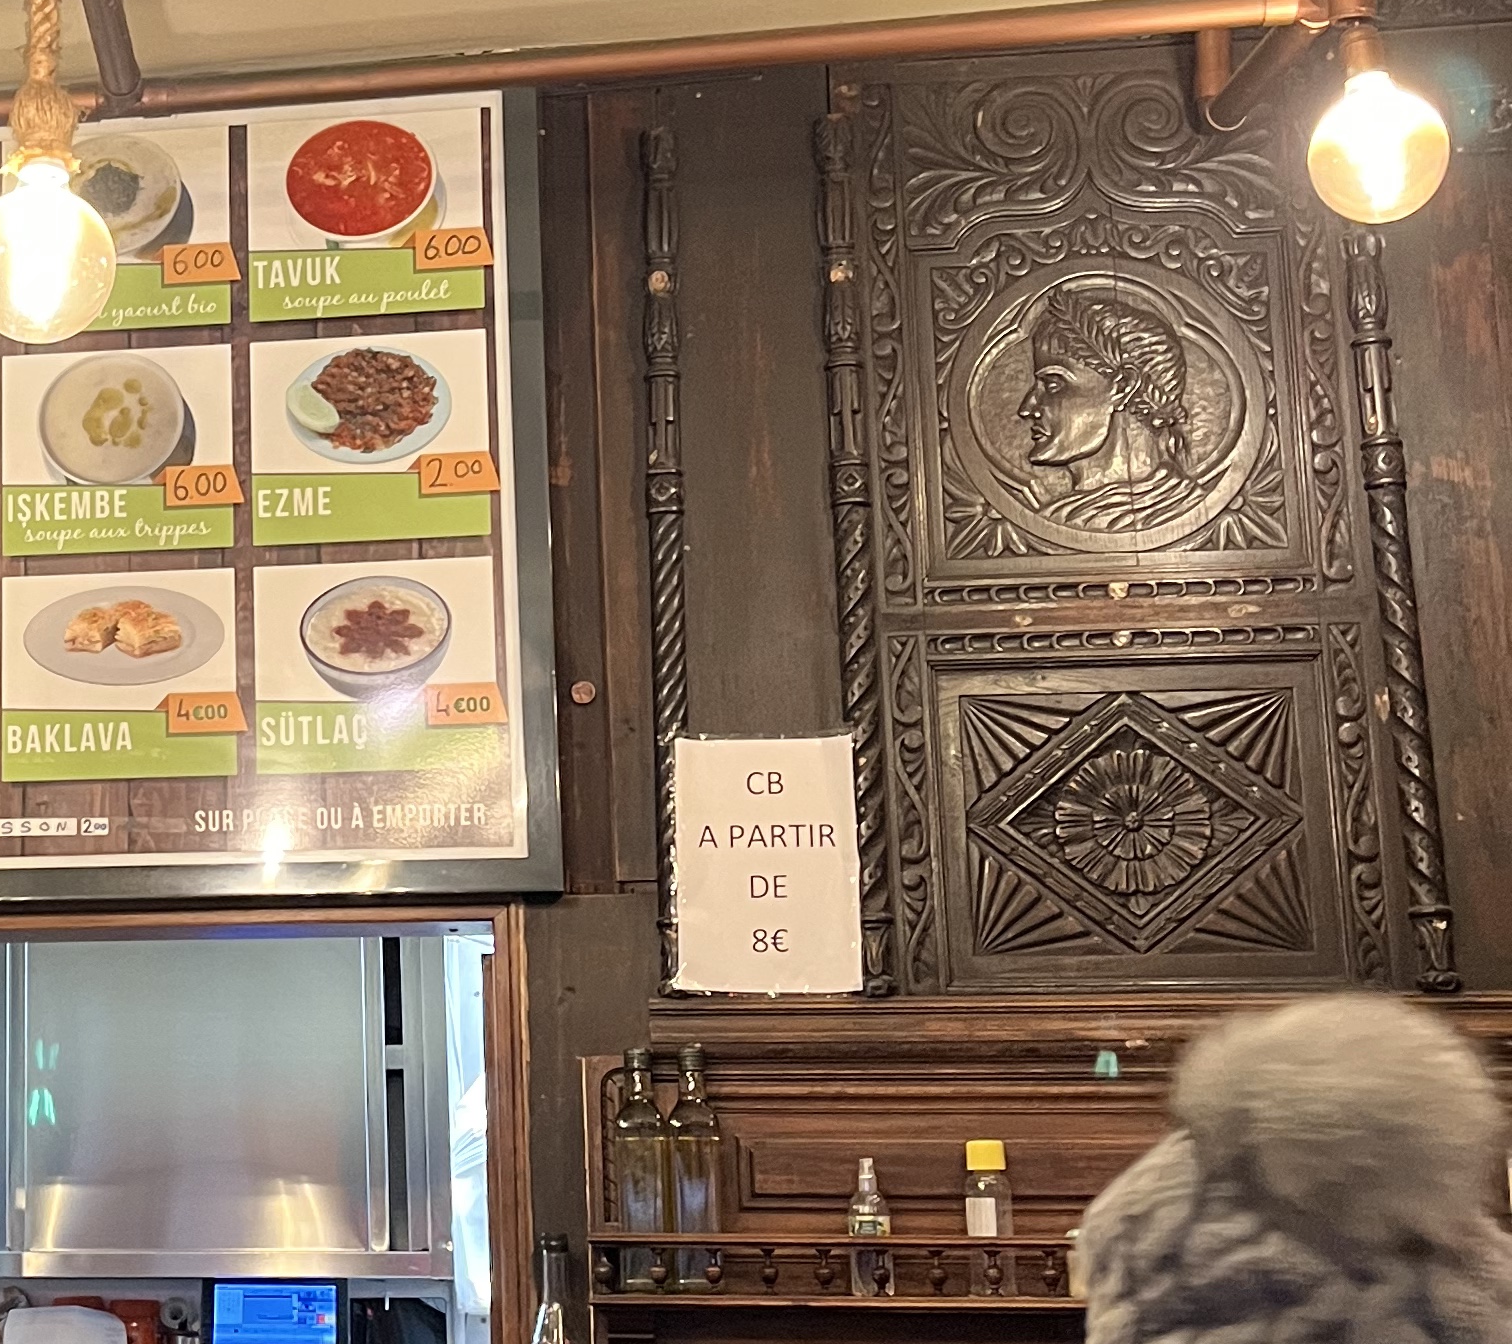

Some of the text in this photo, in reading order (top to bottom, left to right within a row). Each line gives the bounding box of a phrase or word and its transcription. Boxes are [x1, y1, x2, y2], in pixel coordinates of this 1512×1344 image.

[253, 255, 342, 289] TAVUK
[111, 293, 218, 327] yaourt bio
[282, 279, 453, 317] soupe au poulet
[173, 469, 227, 501] 6.00
[257, 486, 332, 518] EZME
[23, 517, 213, 552] soupe aux trippes
[6, 721, 133, 755] BAKLAVA
[261, 711, 368, 751] SÜTLAÇ
[746, 771, 785, 796] CB
[194, 809, 235, 833] SUR
[316, 807, 343, 831] OU
[351, 801, 365, 829] À
[373, 803, 487, 829] EMPORTER
[698, 823, 837, 849] A PARTIR
[750, 874, 789, 900] DE
[752, 928, 790, 954] 8€
